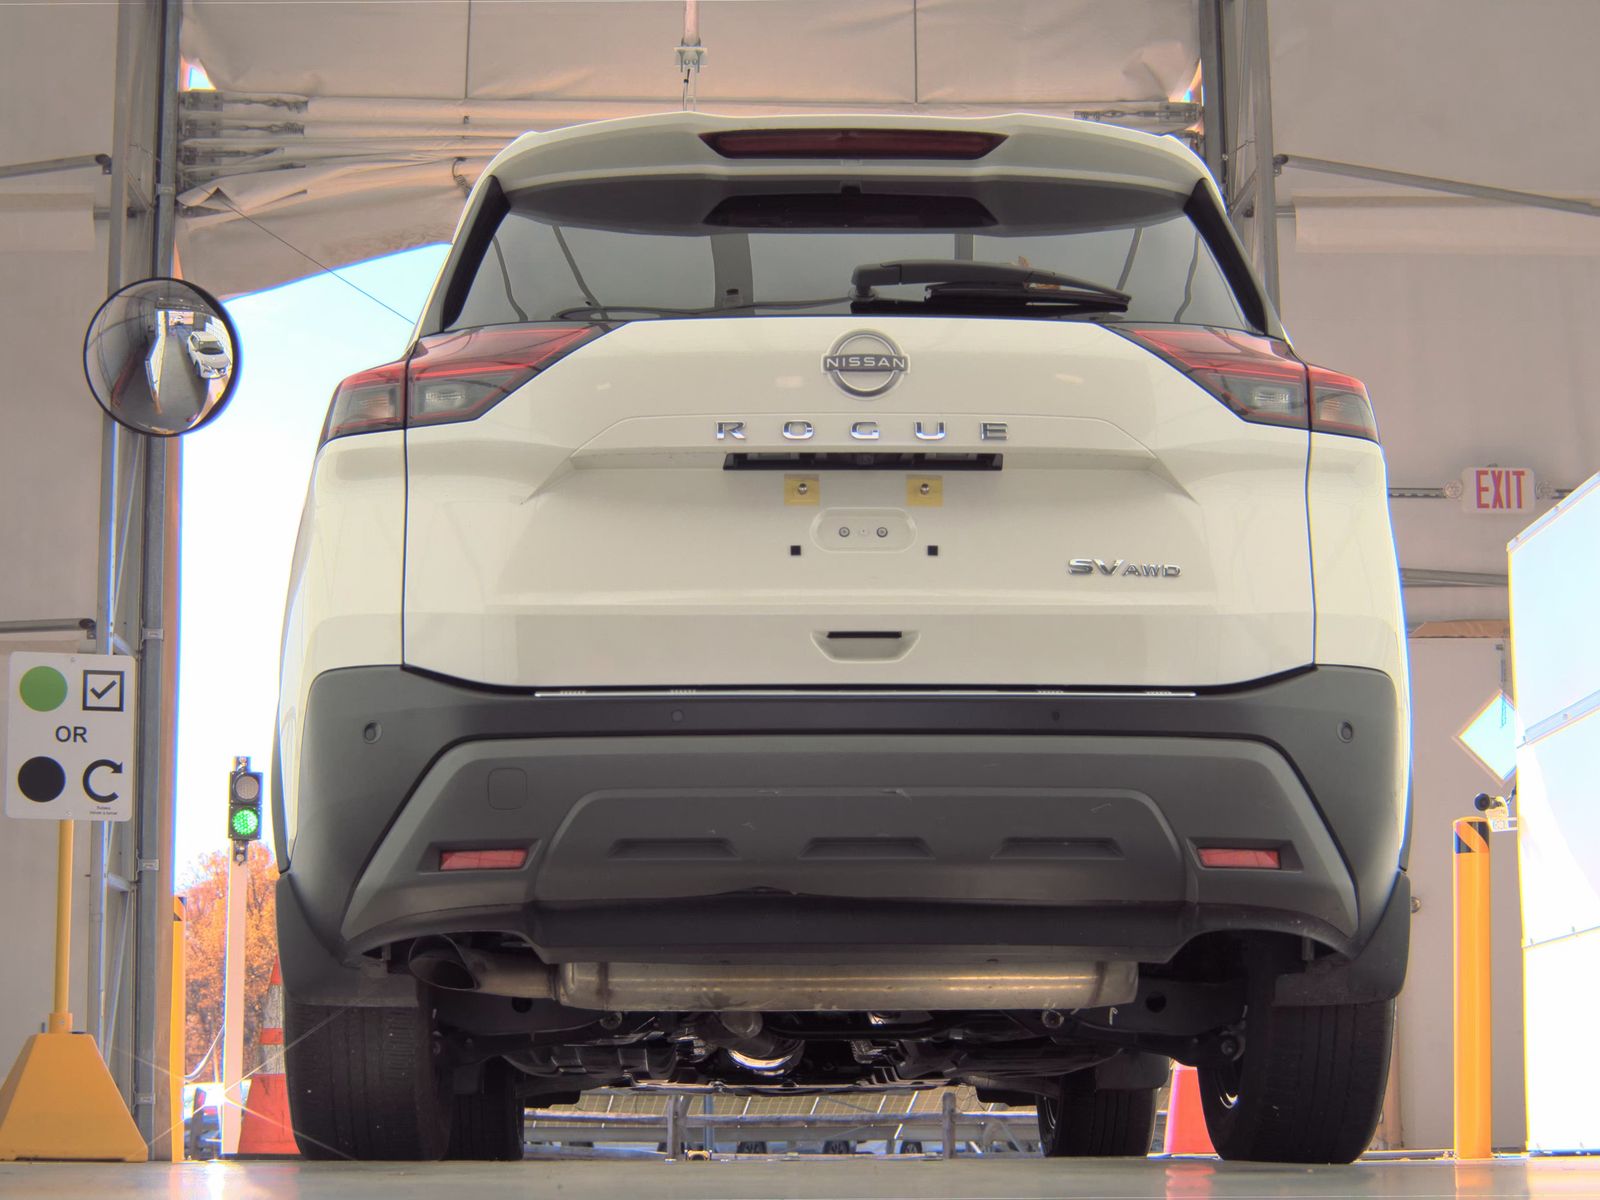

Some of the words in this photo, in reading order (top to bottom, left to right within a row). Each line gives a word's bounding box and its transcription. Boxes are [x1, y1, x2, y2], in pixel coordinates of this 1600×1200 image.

[826, 356, 905, 368] NISSAN
[716, 421, 1008, 440] ROGUE
[1476, 470, 1525, 509] EXIT
[55, 725, 88, 743] OR
